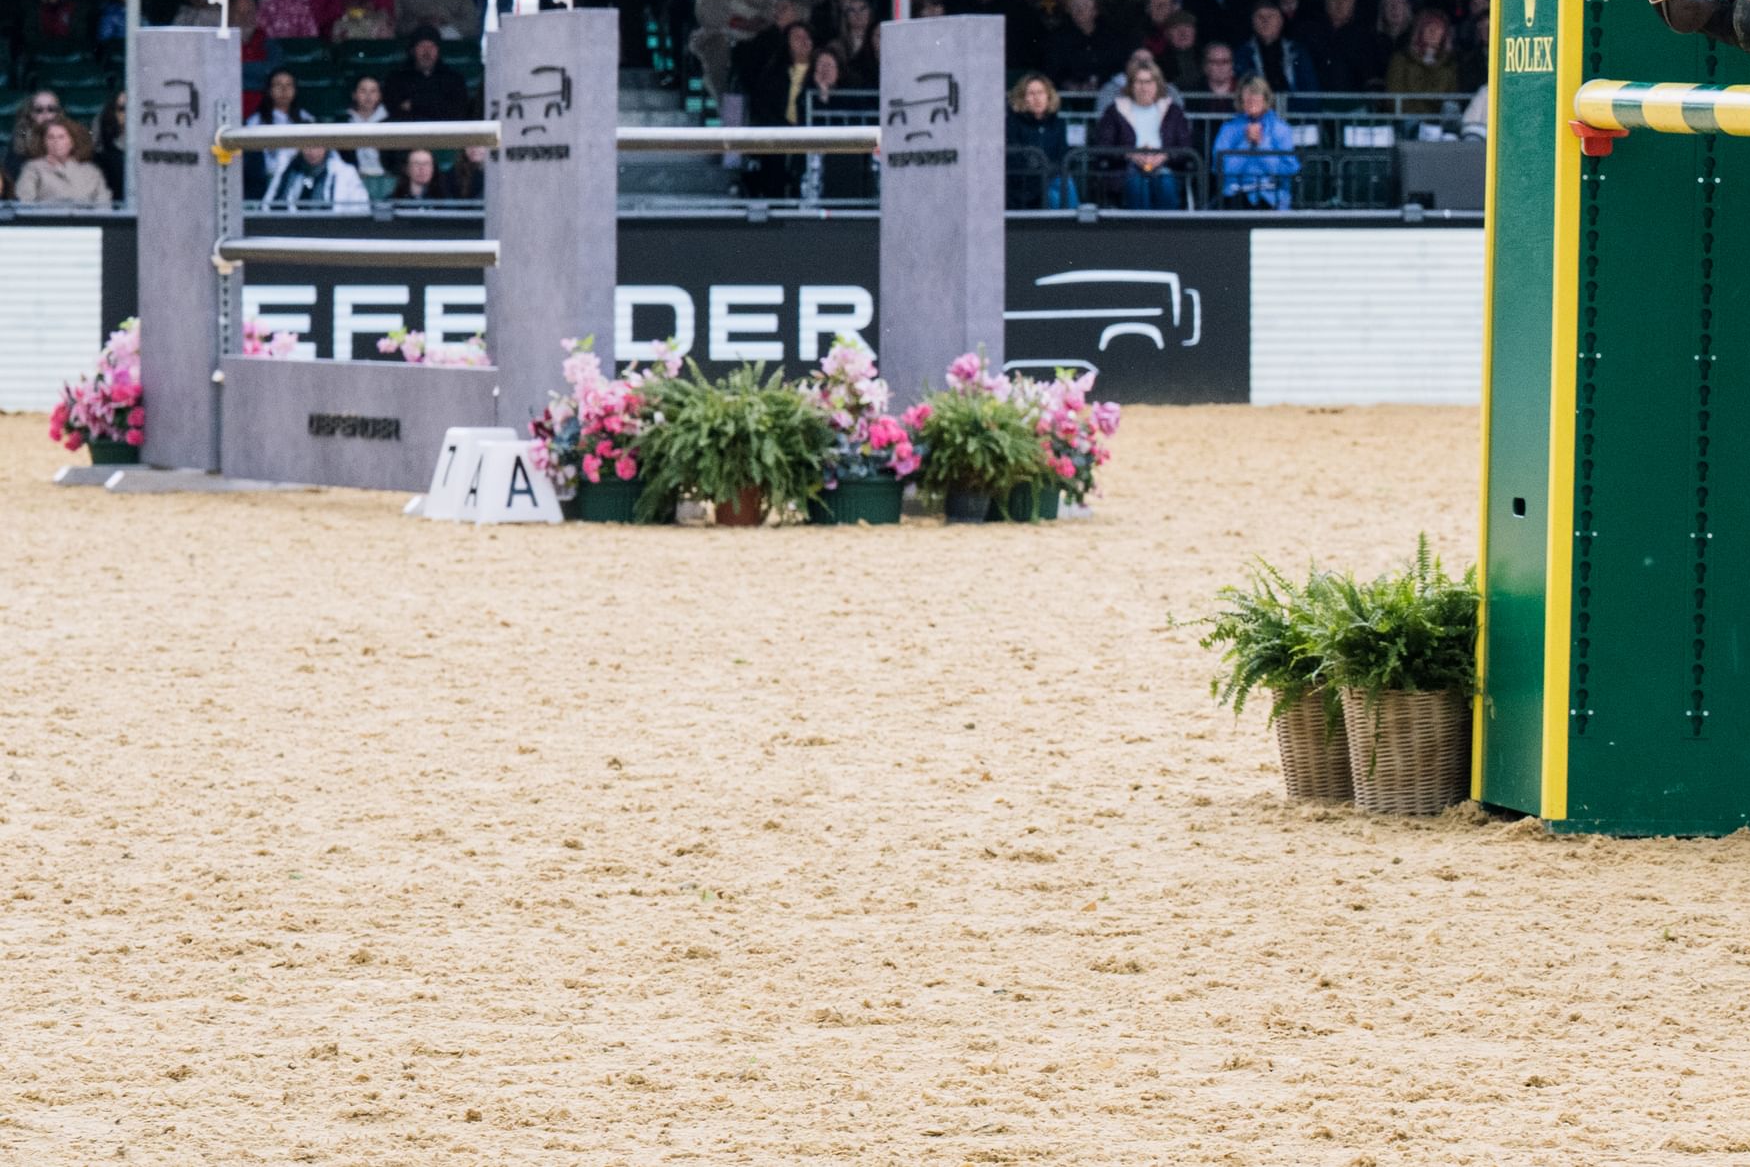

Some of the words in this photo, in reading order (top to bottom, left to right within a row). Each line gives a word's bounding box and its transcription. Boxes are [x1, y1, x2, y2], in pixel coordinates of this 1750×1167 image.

[1504, 36, 1554, 73] ROLEX
[242, 284, 878, 362] EFEDER
[442, 445, 457, 487] 7
[464, 454, 484, 507] A
[505, 455, 538, 507] A
